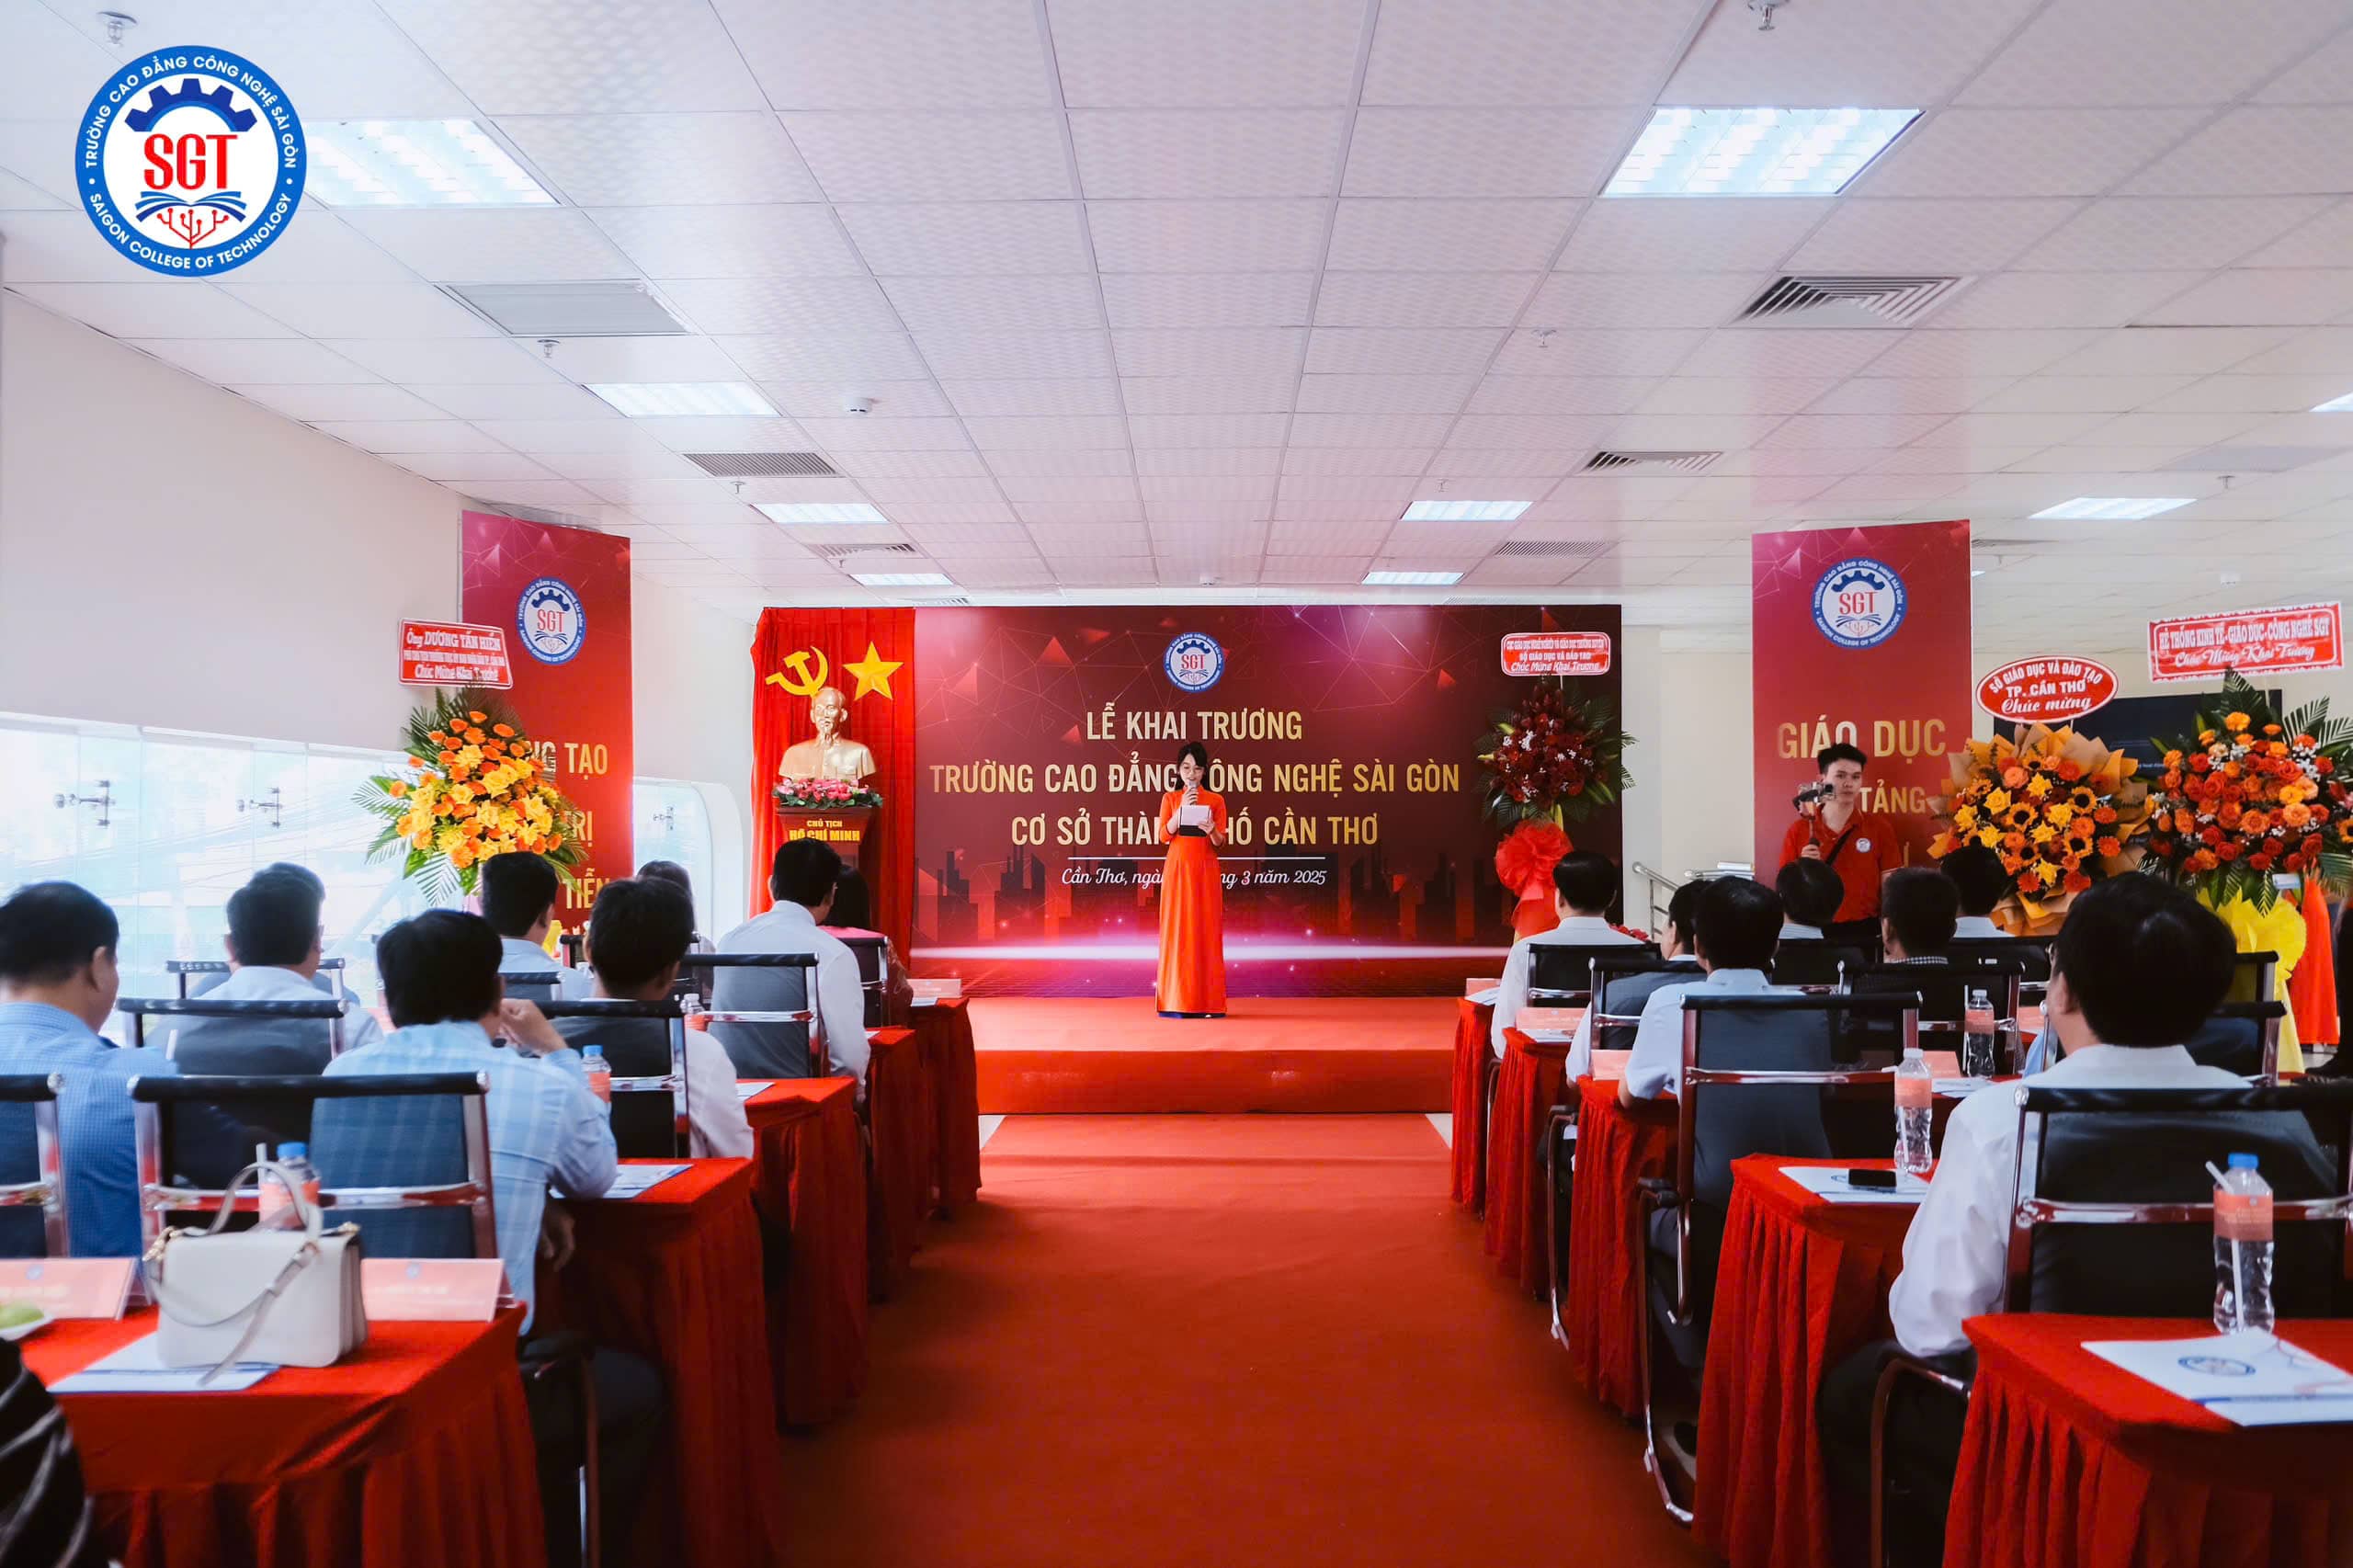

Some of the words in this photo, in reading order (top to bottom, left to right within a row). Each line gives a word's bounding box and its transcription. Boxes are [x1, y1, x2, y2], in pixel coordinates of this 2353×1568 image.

[1838, 591, 1880, 615] SGT
[537, 608, 566, 632] SGT
[1181, 653, 1205, 669] SGT
[1989, 676, 2004, 694] SỞ
[2003, 665, 2025, 685] GIÁO
[2027, 662, 2045, 677] DỤC
[2047, 659, 2060, 675] VÀ
[2062, 661, 2082, 676] ĐÀO
[2084, 666, 2103, 685] TẠO
[2006, 686, 2027, 699] TP.
[2059, 678, 2086, 694] THƠ
[2001, 698, 2041, 714] Chúc
[2044, 696, 2092, 711] mừng
[1086, 701, 1116, 740] LỄ
[1126, 711, 1187, 740] KHAI
[1198, 707, 1302, 740] TRƯƠNG
[1778, 714, 1858, 759] GIÁO
[1873, 719, 1947, 765] DỤC
[563, 742, 608, 780] TẠO
[928, 758, 1034, 793] TRƯỜNG
[1044, 764, 1097, 792] CAO
[1108, 751, 1177, 792] ĐẲNG
[1209, 758, 1262, 792] ÔNG
[1274, 758, 1343, 798] NGHỆ
[1353, 758, 1394, 792] SÀI
[1406, 758, 1460, 792] GÒN
[1859, 778, 1927, 813] TẢNG
[789, 828, 805, 841] HỒ
[807, 828, 827, 841] CHÍ
[829, 830, 860, 841] MINH
[806, 818, 824, 827] CHỦ
[825, 820, 843, 828] TỊCH
[1011, 812, 1046, 846] CƠ
[1057, 807, 1091, 846] SỞ
[1101, 811, 1165, 846] THÀ
[1224, 806, 1253, 846] HỐ
[1264, 807, 1317, 846] CẦN
[1327, 812, 1378, 846] THƠ
[1062, 868, 1092, 884] Cần
[1096, 869, 1128, 887] Thơ,
[1131, 869, 1165, 890] ngà
[1241, 870, 1250, 885] 3
[1254, 870, 1290, 884] năm
[1294, 870, 1326, 885] 2025
